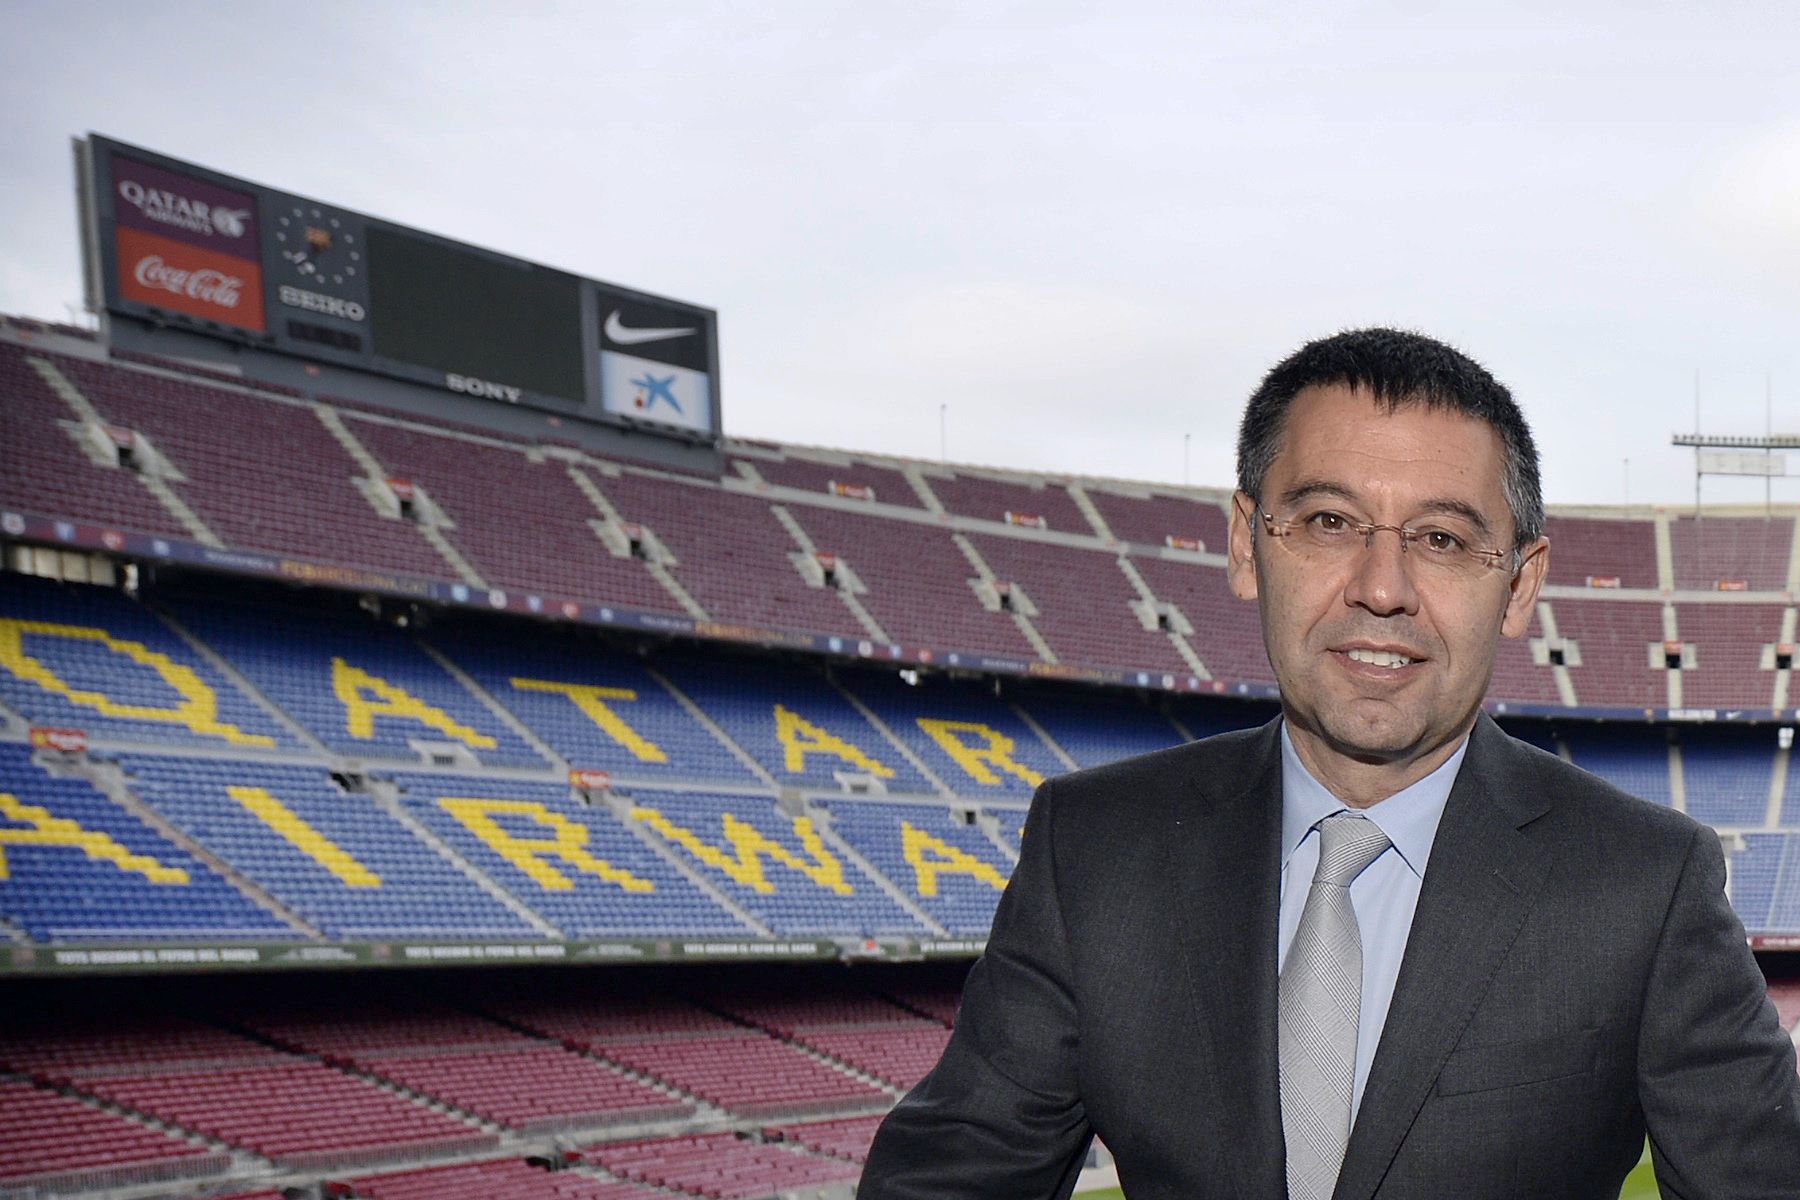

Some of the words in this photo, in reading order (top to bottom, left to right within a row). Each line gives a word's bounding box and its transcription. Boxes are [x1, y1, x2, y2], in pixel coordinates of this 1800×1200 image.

[119, 179, 211, 222] QATAR
[279, 285, 366, 322] SEIKO
[446, 371, 522, 403] SONY
[0, 618, 1046, 786] QATAR
[0, 786, 1024, 897] AIRWA
